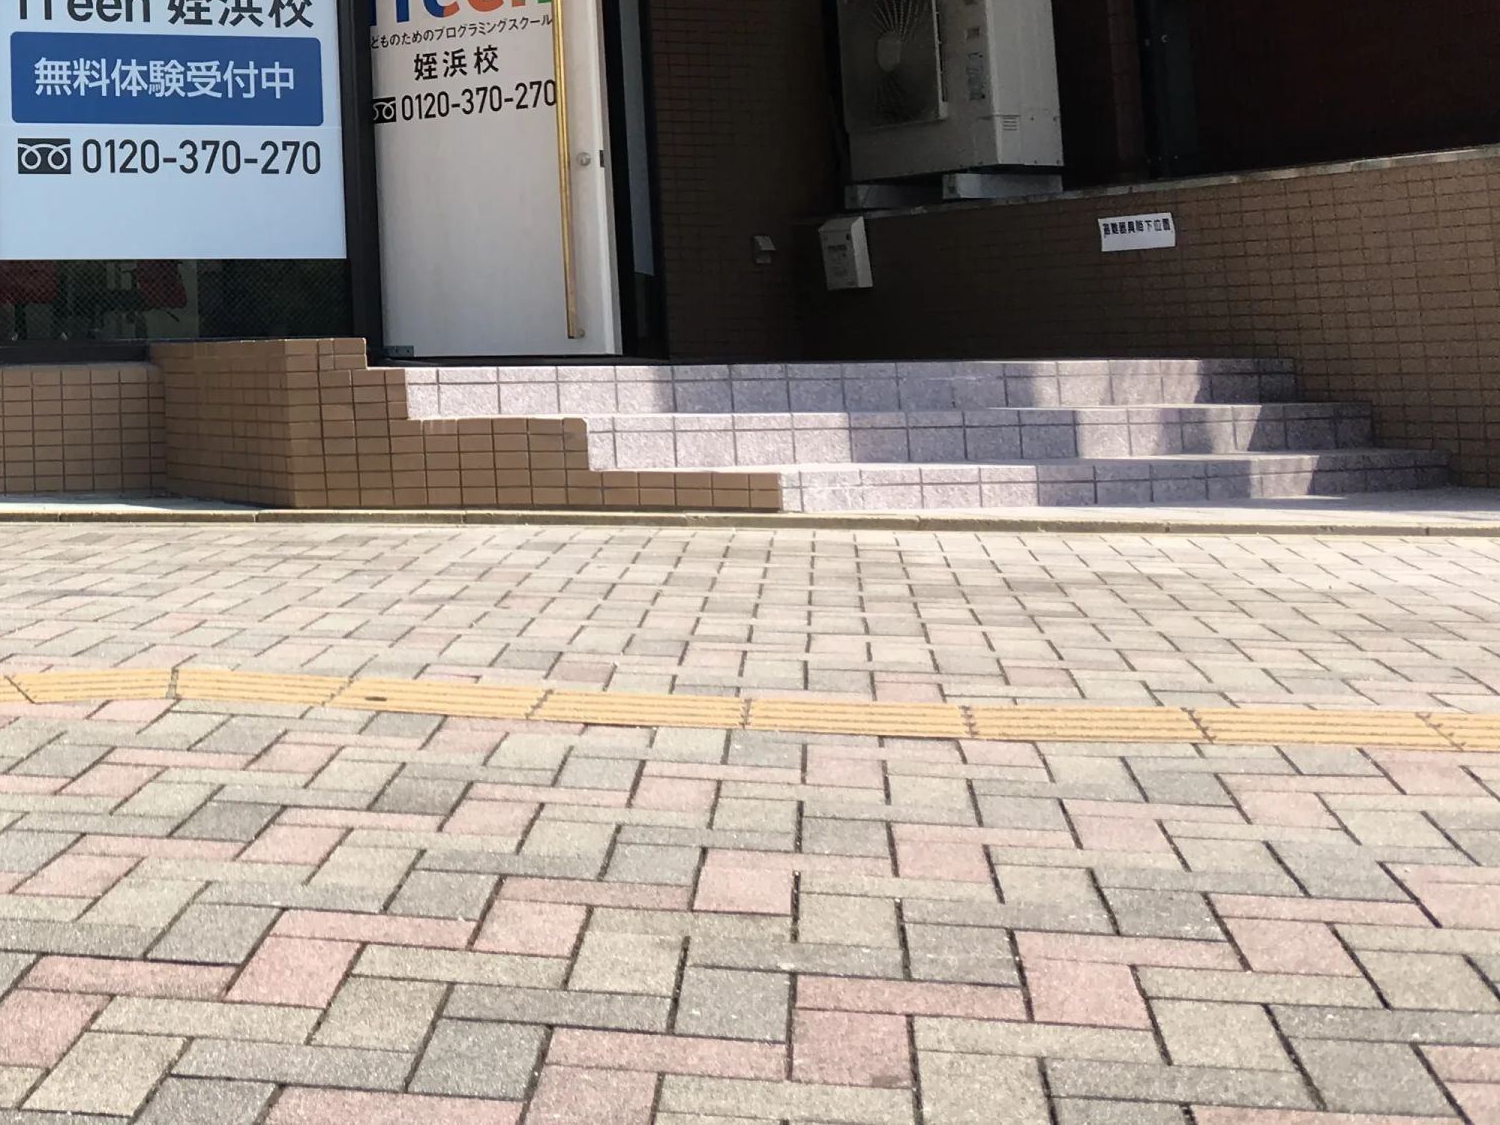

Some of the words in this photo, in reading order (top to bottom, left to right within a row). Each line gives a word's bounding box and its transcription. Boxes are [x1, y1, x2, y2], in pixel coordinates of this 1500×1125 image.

[33, 57, 295, 99] 無料体験受付中
[413, 44, 500, 81] 姪浜校
[401, 79, 557, 121] 0120-370-270
[82, 138, 322, 175] 0120-370-270
